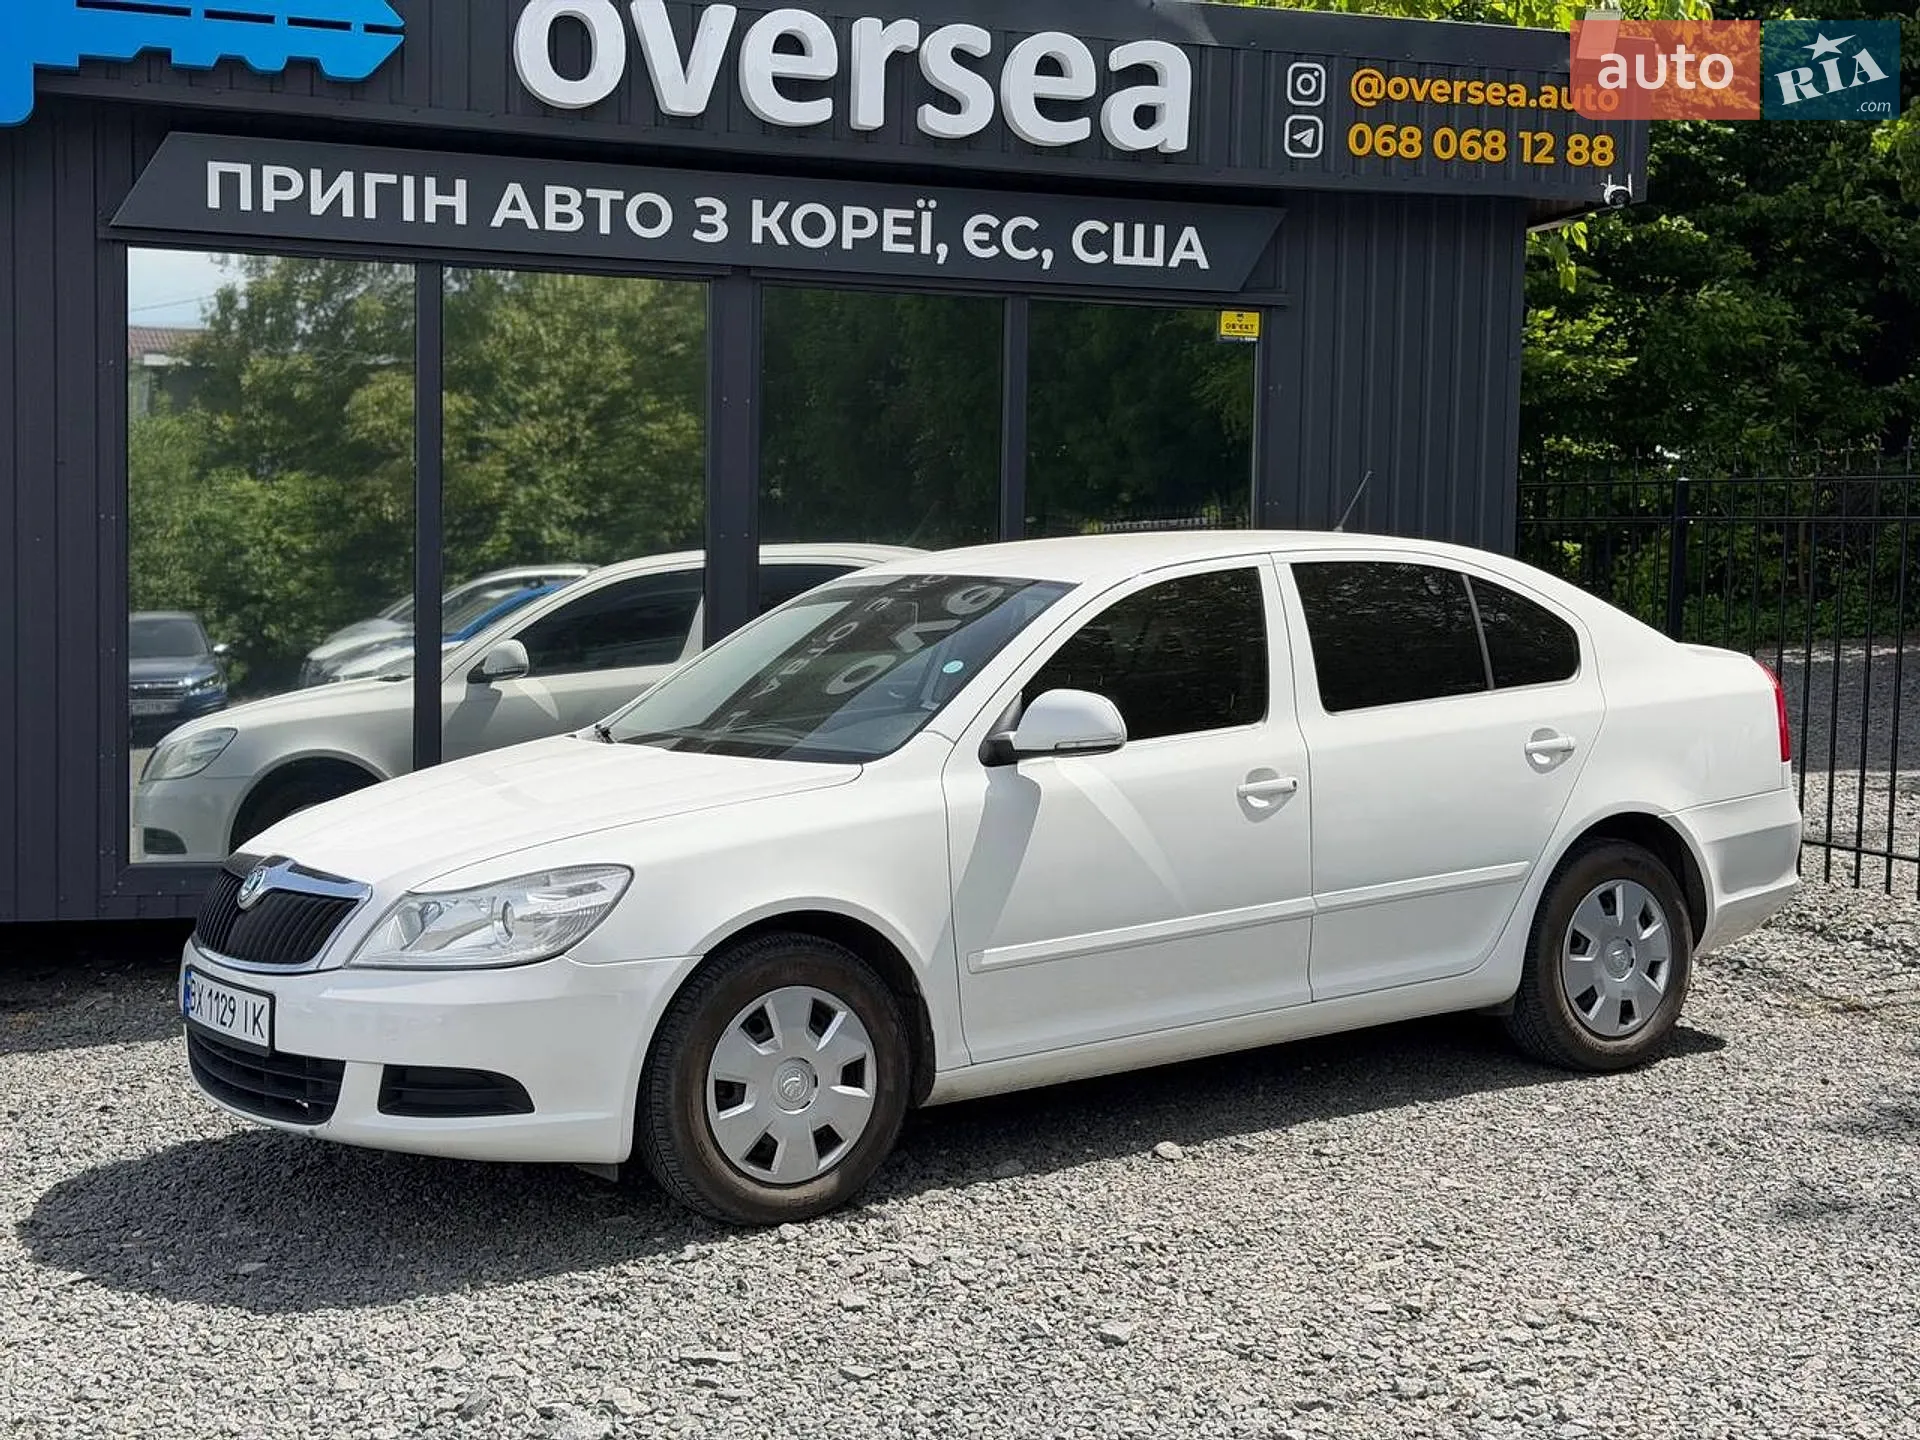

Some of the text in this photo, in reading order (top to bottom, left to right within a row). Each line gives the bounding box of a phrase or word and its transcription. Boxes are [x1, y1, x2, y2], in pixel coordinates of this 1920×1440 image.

[513, 0, 1191, 153] oversea
[1350, 68, 1620, 113] @oversea.auto
[1348, 122, 1615, 167] 068 068 12 88
[207, 160, 1210, 270] ПРИГІН АВТО З КОРЕЇ, ЄС, США
[207, 988, 236, 1028] 1129
[244, 999, 265, 1039] IK
